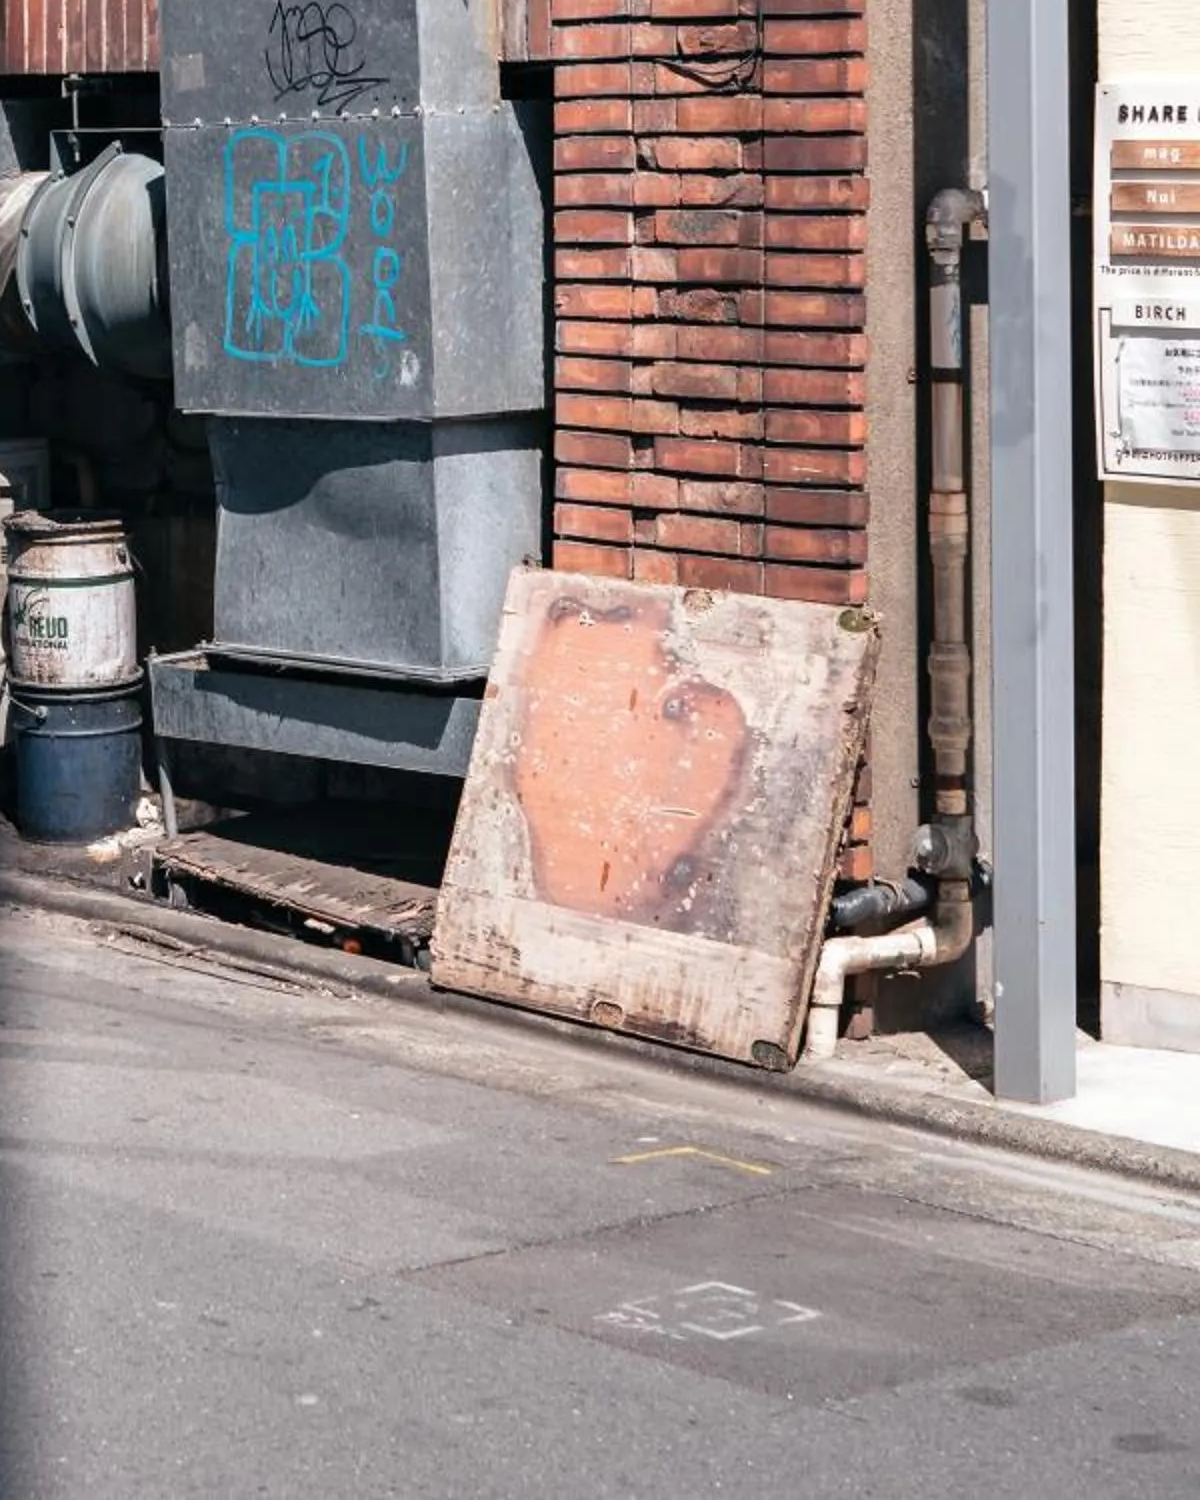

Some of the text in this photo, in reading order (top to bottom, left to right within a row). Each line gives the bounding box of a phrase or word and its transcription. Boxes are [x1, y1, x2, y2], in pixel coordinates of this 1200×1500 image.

[1117, 104, 1188, 124] SHARE
[1122, 232, 1200, 250] MATILDA
[1099, 265, 1116, 275] The
[1135, 305, 1187, 321] BIRCH
[29, 615, 68, 638] REVO
